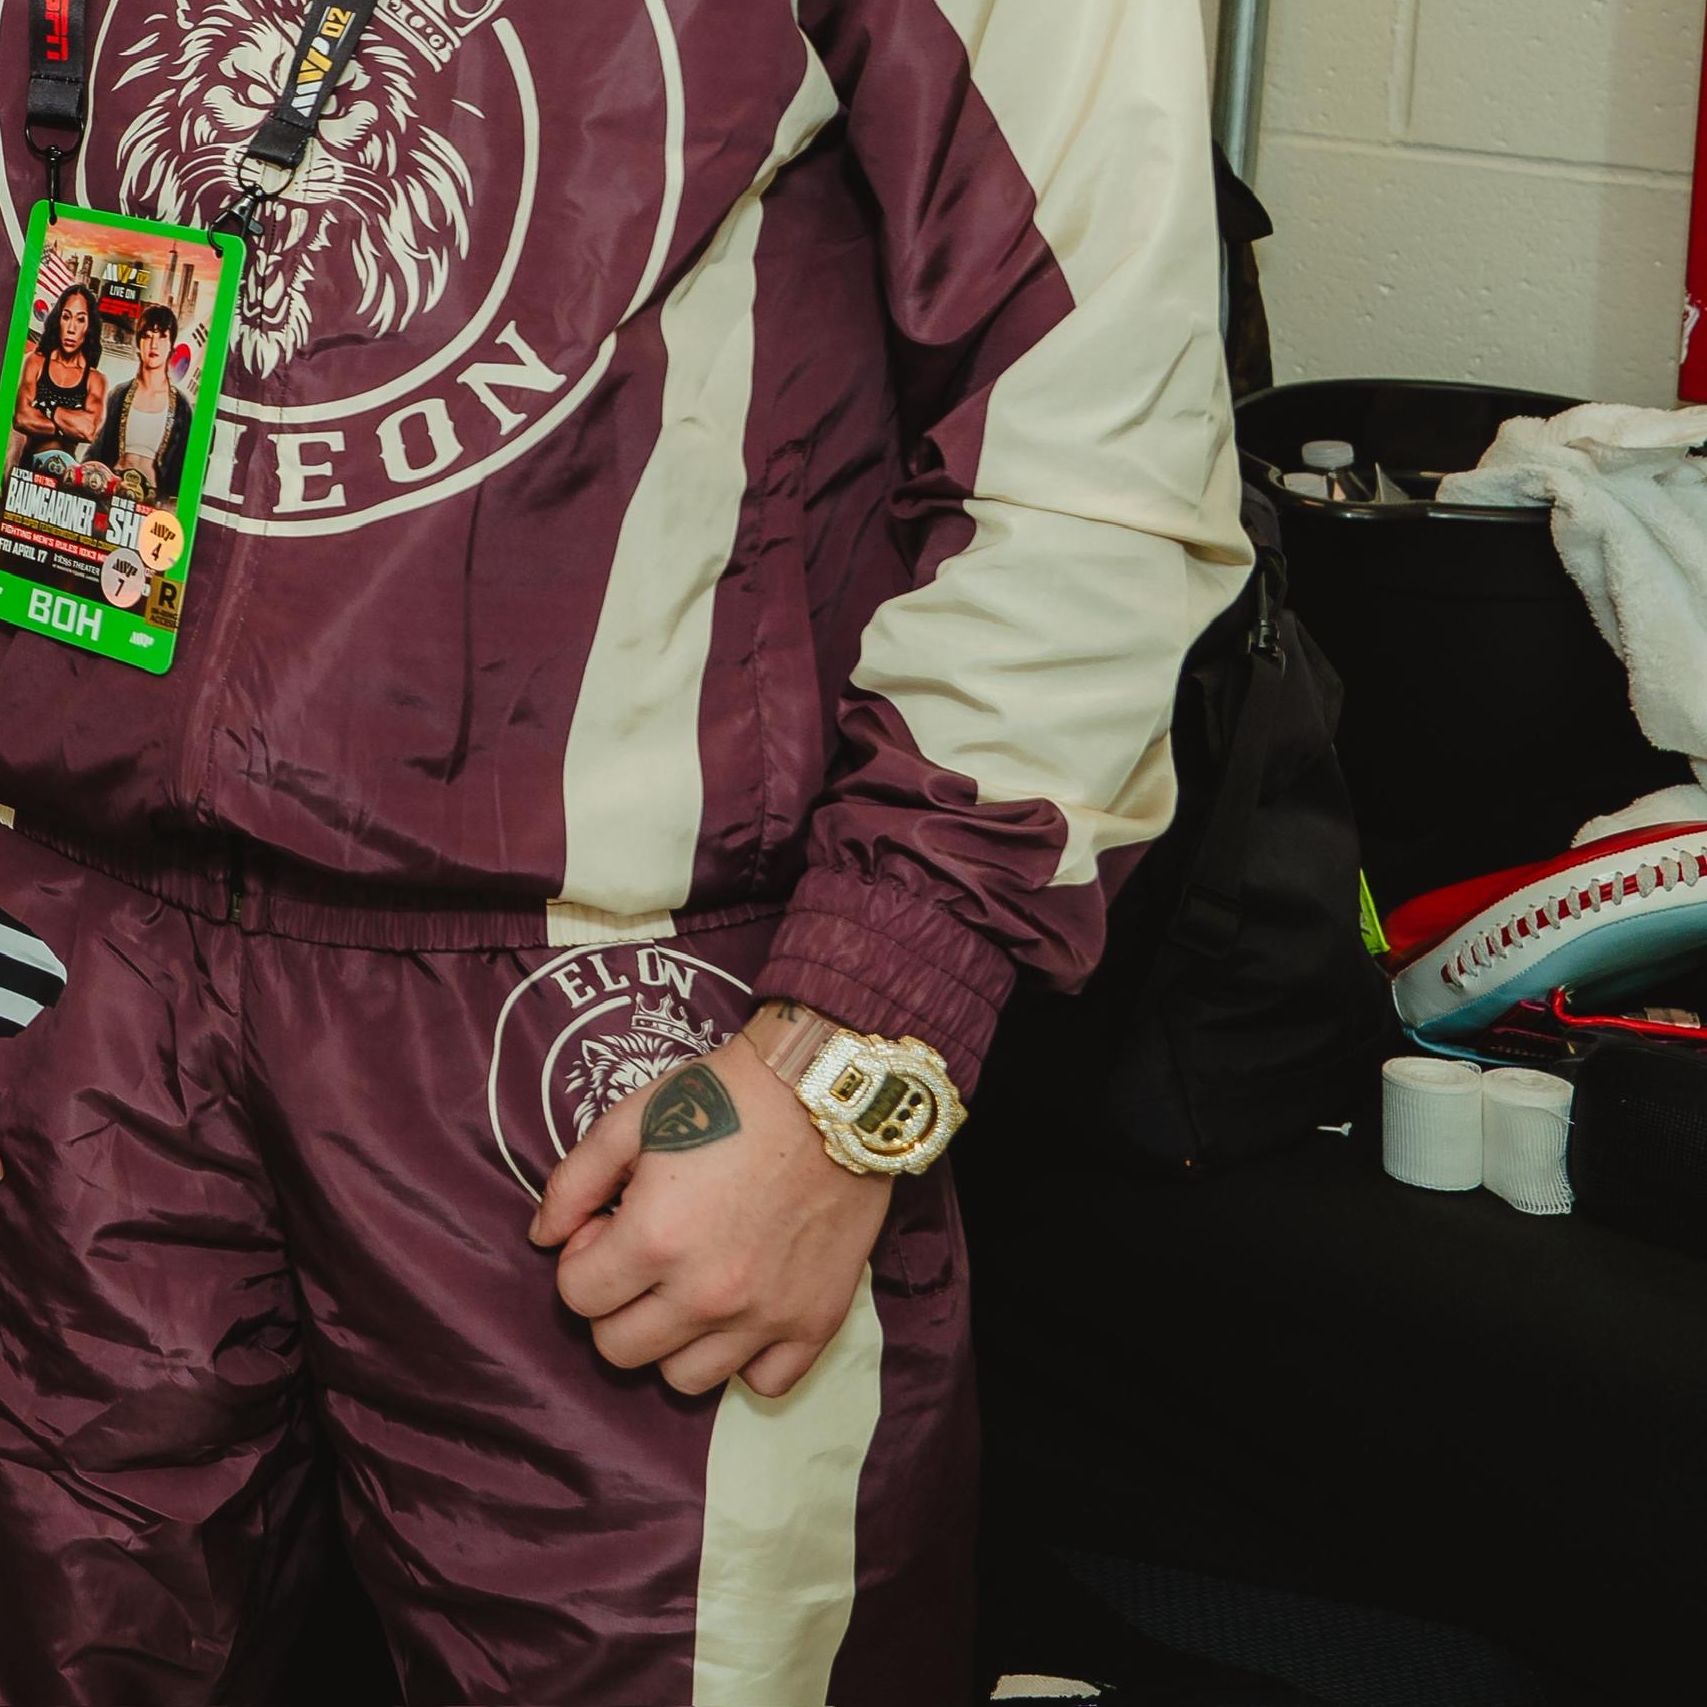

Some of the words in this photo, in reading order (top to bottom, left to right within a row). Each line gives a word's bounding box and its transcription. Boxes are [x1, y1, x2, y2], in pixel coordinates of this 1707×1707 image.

[291, 37, 333, 118] MVP
[321, 7, 352, 38] 02
[102, 263, 137, 283] MVP
[109, 285, 125, 298] LIVE
[125, 288, 136, 300] ON
[98, 296, 141, 319] ESPN
[4, 476, 96, 537] BAUMGARDNER
[105, 506, 143, 551] SH
[12, 541, 37, 561] APRIL
[37, 548, 48, 564] 17
[151, 541, 162, 561] 4
[114, 577, 125, 597] 7
[158, 581, 177, 610] R
[28, 588, 103, 641] BOH
[551, 947, 697, 1010] ELON
